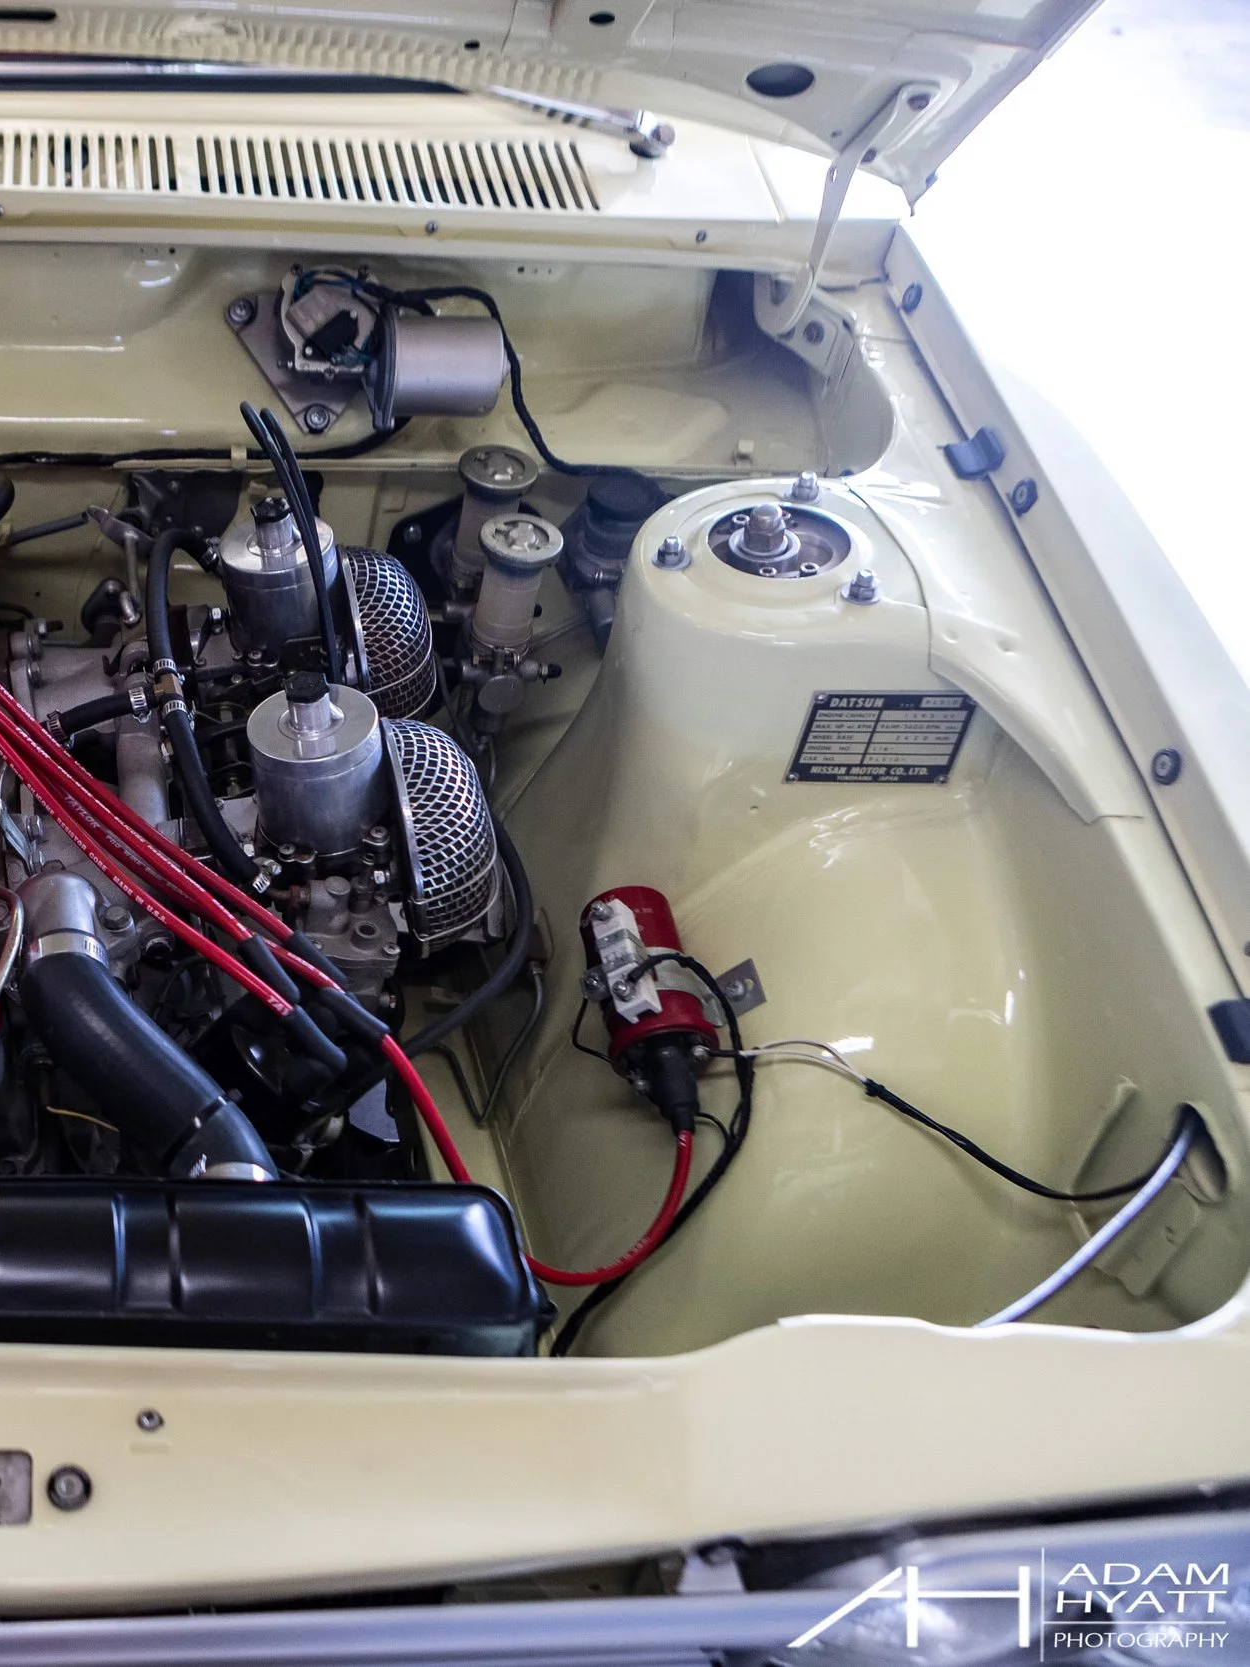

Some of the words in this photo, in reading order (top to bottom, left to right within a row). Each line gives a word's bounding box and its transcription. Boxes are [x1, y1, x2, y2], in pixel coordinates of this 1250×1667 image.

[829, 697, 885, 708] DATSUN
[810, 766, 848, 775] NISSAN
[850, 766, 887, 775] MOTOR
[908, 767, 929, 776] LTD.
[65, 794, 101, 830] TAYLOR
[56, 817, 87, 851] RESISTOR
[88, 852, 109, 873] CORE
[112, 875, 134, 896] MADE
[135, 895, 145, 905] IN
[146, 904, 168, 925] U.S.A.
